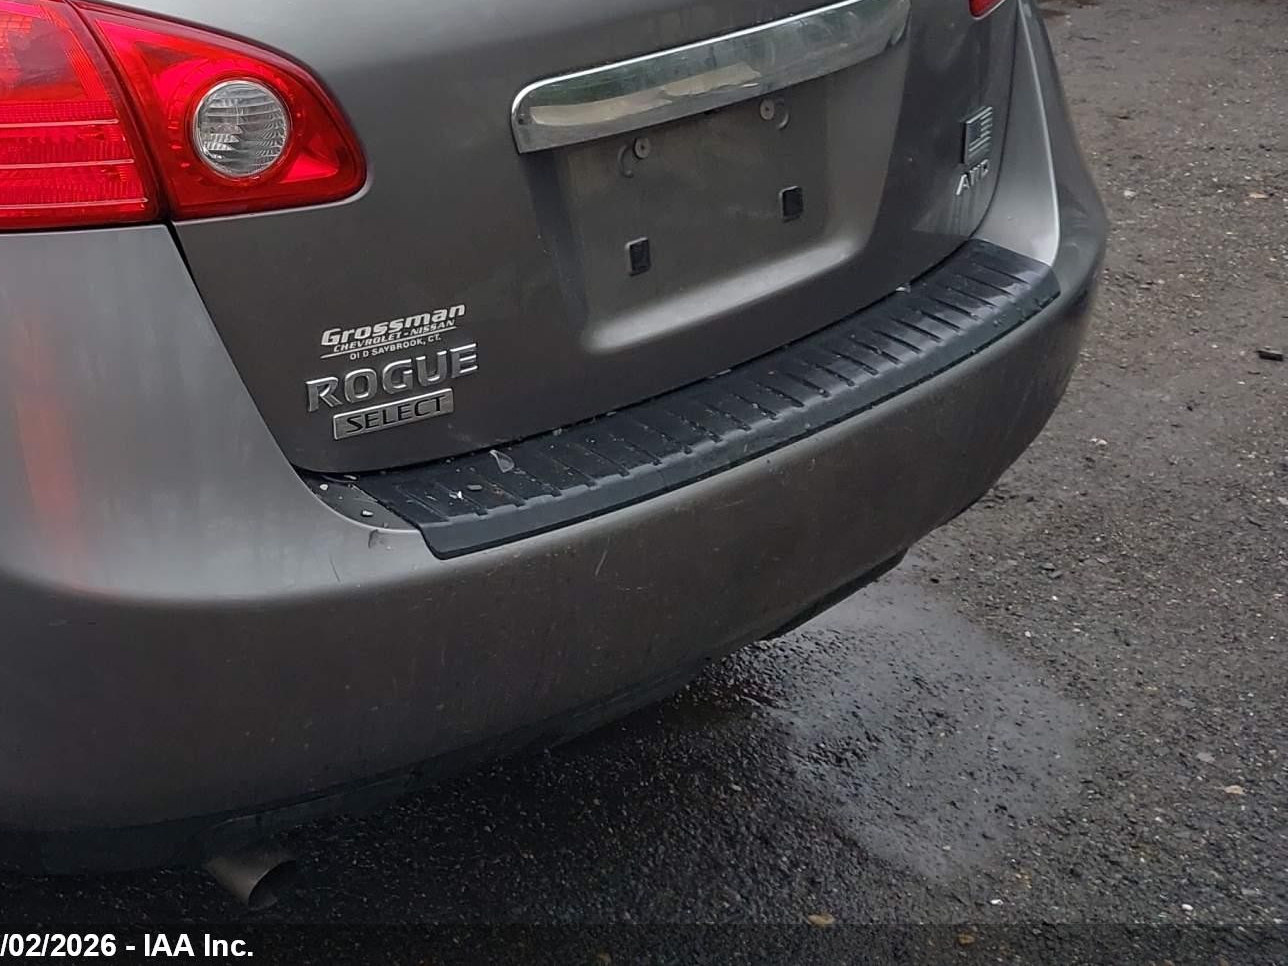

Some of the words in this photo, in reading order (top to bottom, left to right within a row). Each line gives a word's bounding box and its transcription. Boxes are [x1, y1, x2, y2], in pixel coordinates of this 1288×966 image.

[321, 304, 466, 346] Grossman
[305, 343, 478, 412] ROGUE
[345, 393, 448, 434] SELECT
